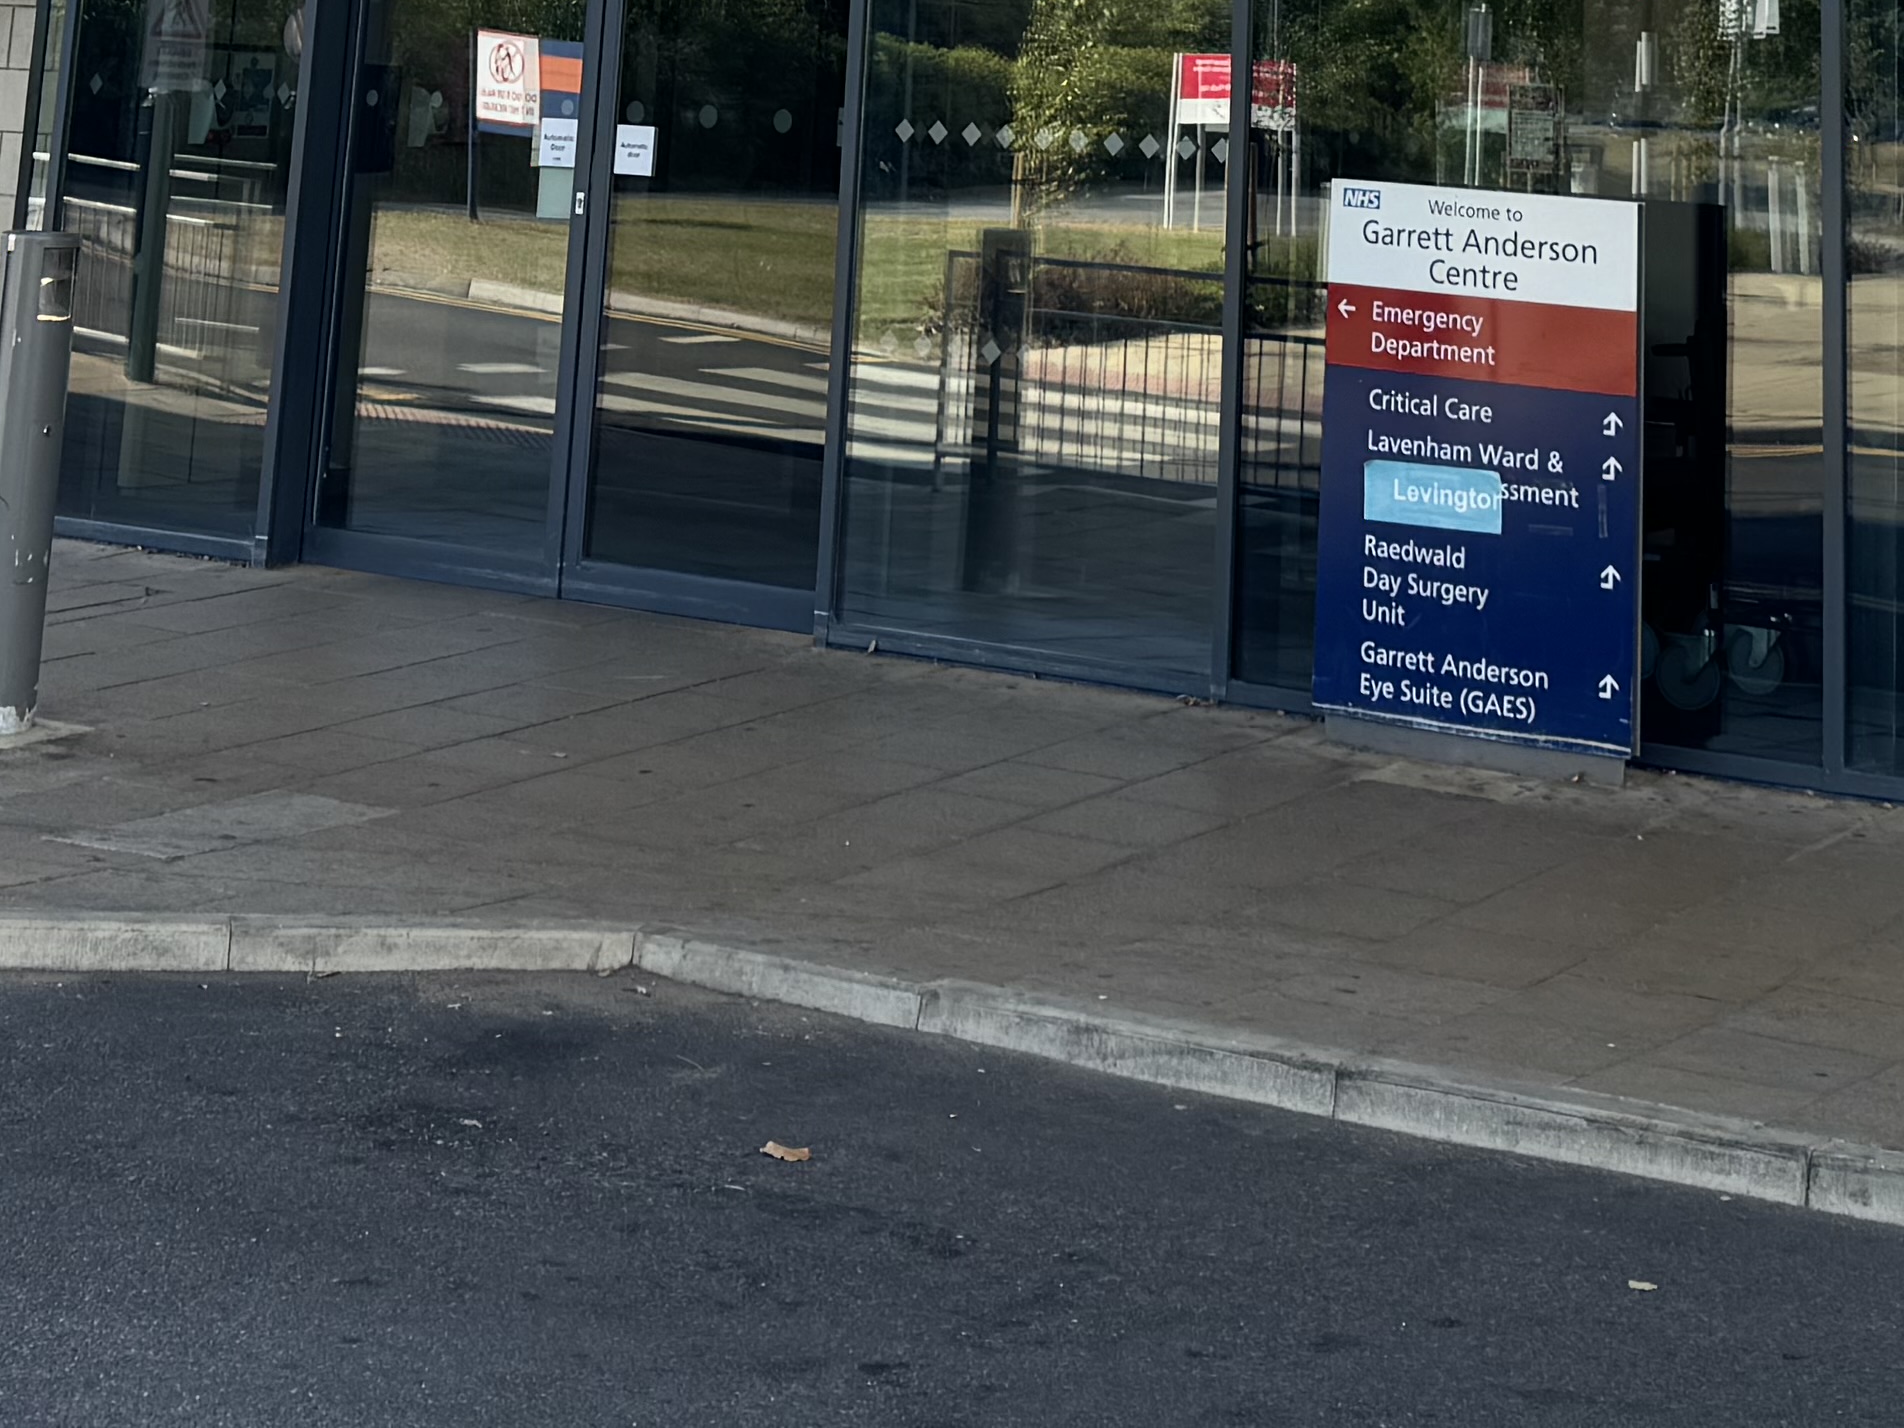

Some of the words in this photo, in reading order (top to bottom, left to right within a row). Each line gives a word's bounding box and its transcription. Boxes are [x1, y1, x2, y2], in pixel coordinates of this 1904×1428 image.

[1344, 190, 1380, 208] NHS
[1428, 199, 1500, 221] Welcome
[1506, 207, 1523, 222] to
[1363, 219, 1453, 252] Garrett
[1462, 228, 1598, 265] Anderson
[1429, 259, 1518, 292] Centre
[1372, 300, 1485, 336] Emergency
[1371, 331, 1496, 367] Department
[1368, 388, 1439, 418] Critical
[1444, 396, 1493, 424] Care
[1367, 429, 1472, 463] Lavenham
[1478, 443, 1540, 471] Ward
[1548, 451, 1563, 474] &
[1365, 534, 1466, 570] Raedwald
[1363, 567, 1402, 597] Day
[1408, 573, 1489, 610] Surgery
[1362, 598, 1406, 627] Unit
[1360, 641, 1436, 673] Garrett
[1442, 654, 1549, 689] Anderson
[1359, 673, 1396, 704] Eye
[1400, 678, 1454, 709] Suite
[1460, 687, 1536, 724] (GAES)
